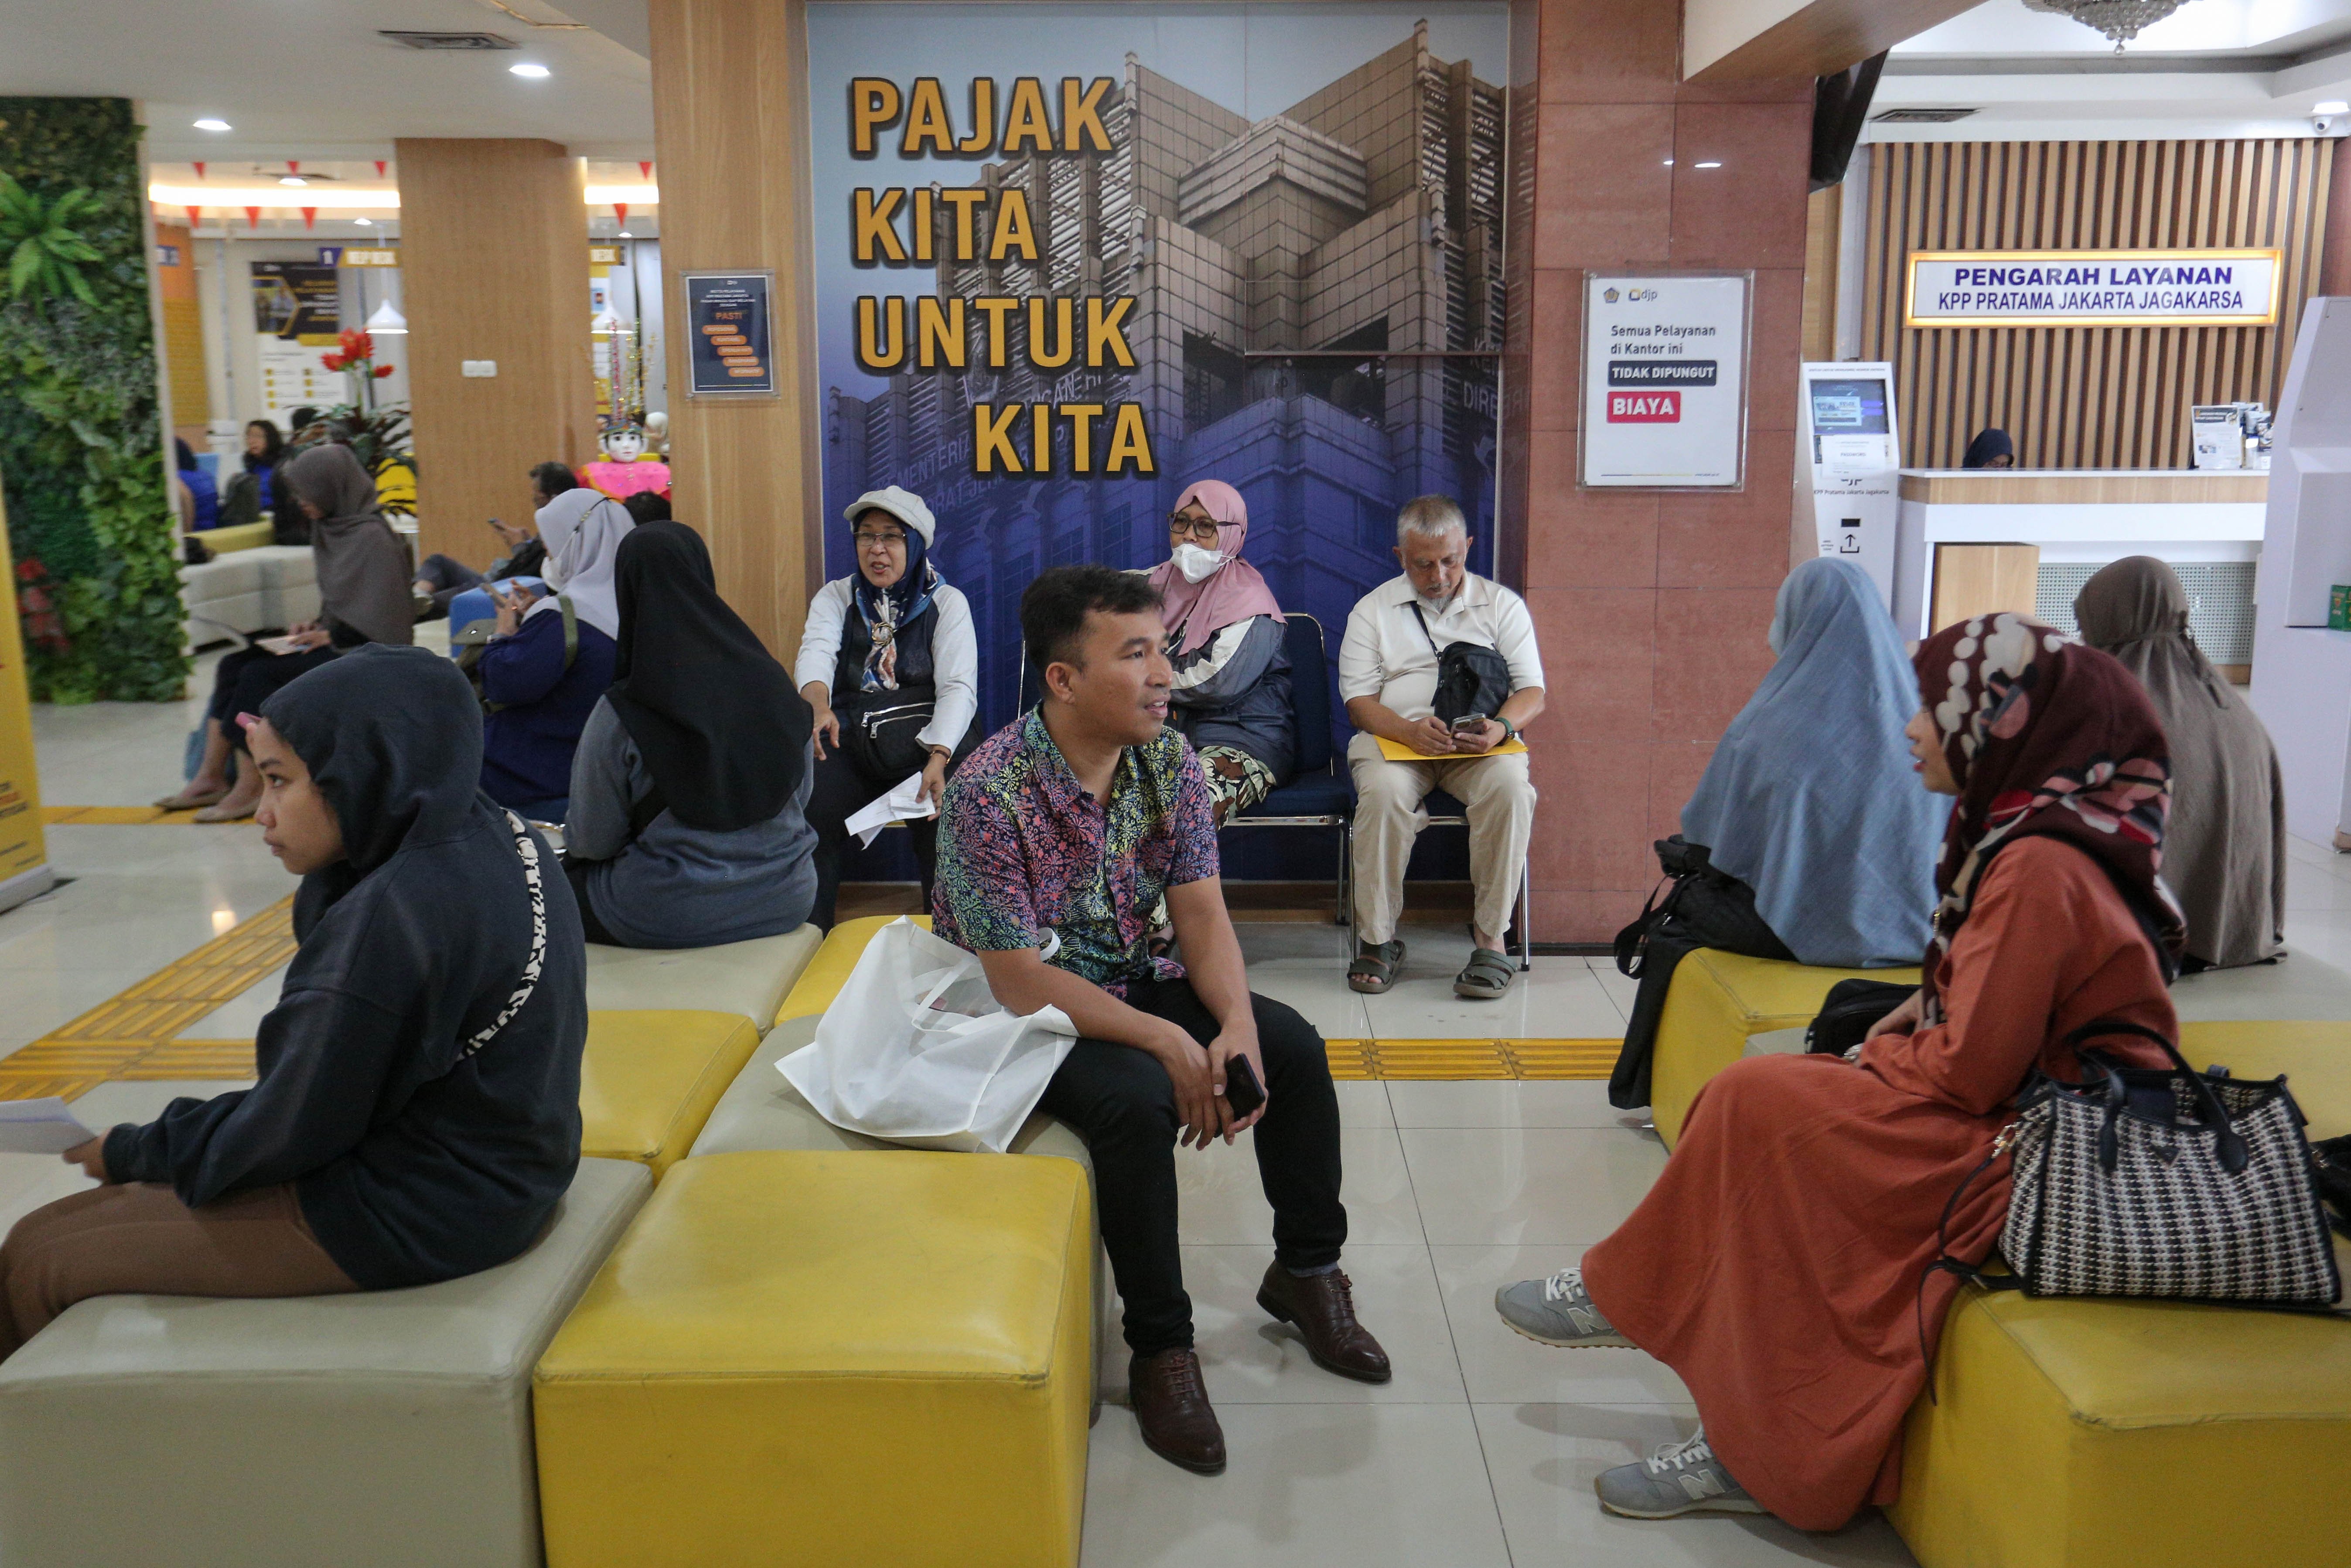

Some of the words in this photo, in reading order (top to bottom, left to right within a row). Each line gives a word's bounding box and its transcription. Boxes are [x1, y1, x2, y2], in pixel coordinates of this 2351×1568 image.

[853, 79, 1112, 153] PAJAK
[855, 189, 1039, 261] KITA
[1954, 267, 2099, 286] PENGARAH
[2109, 266, 2232, 285] LAYANAN
[1641, 289, 1657, 301] djp
[1939, 293, 1971, 310] KPP
[1976, 292, 2054, 310] PRATAMA
[2058, 291, 2134, 310] JAKARTA
[2139, 290, 2242, 310] JAGAKARSA
[859, 297, 1135, 368] UNTUK
[1611, 325, 1651, 337] Semua
[1655, 325, 1716, 338] Pelayanan
[1611, 343, 1621, 355] di
[1625, 344, 1665, 355] Kantor
[1668, 343, 1682, 355] ini
[1612, 367, 1650, 378] TIDAK
[1652, 367, 1715, 378] DIPUNGUT
[1613, 398, 1674, 416] BIAYA
[975, 403, 1154, 473] KITA
